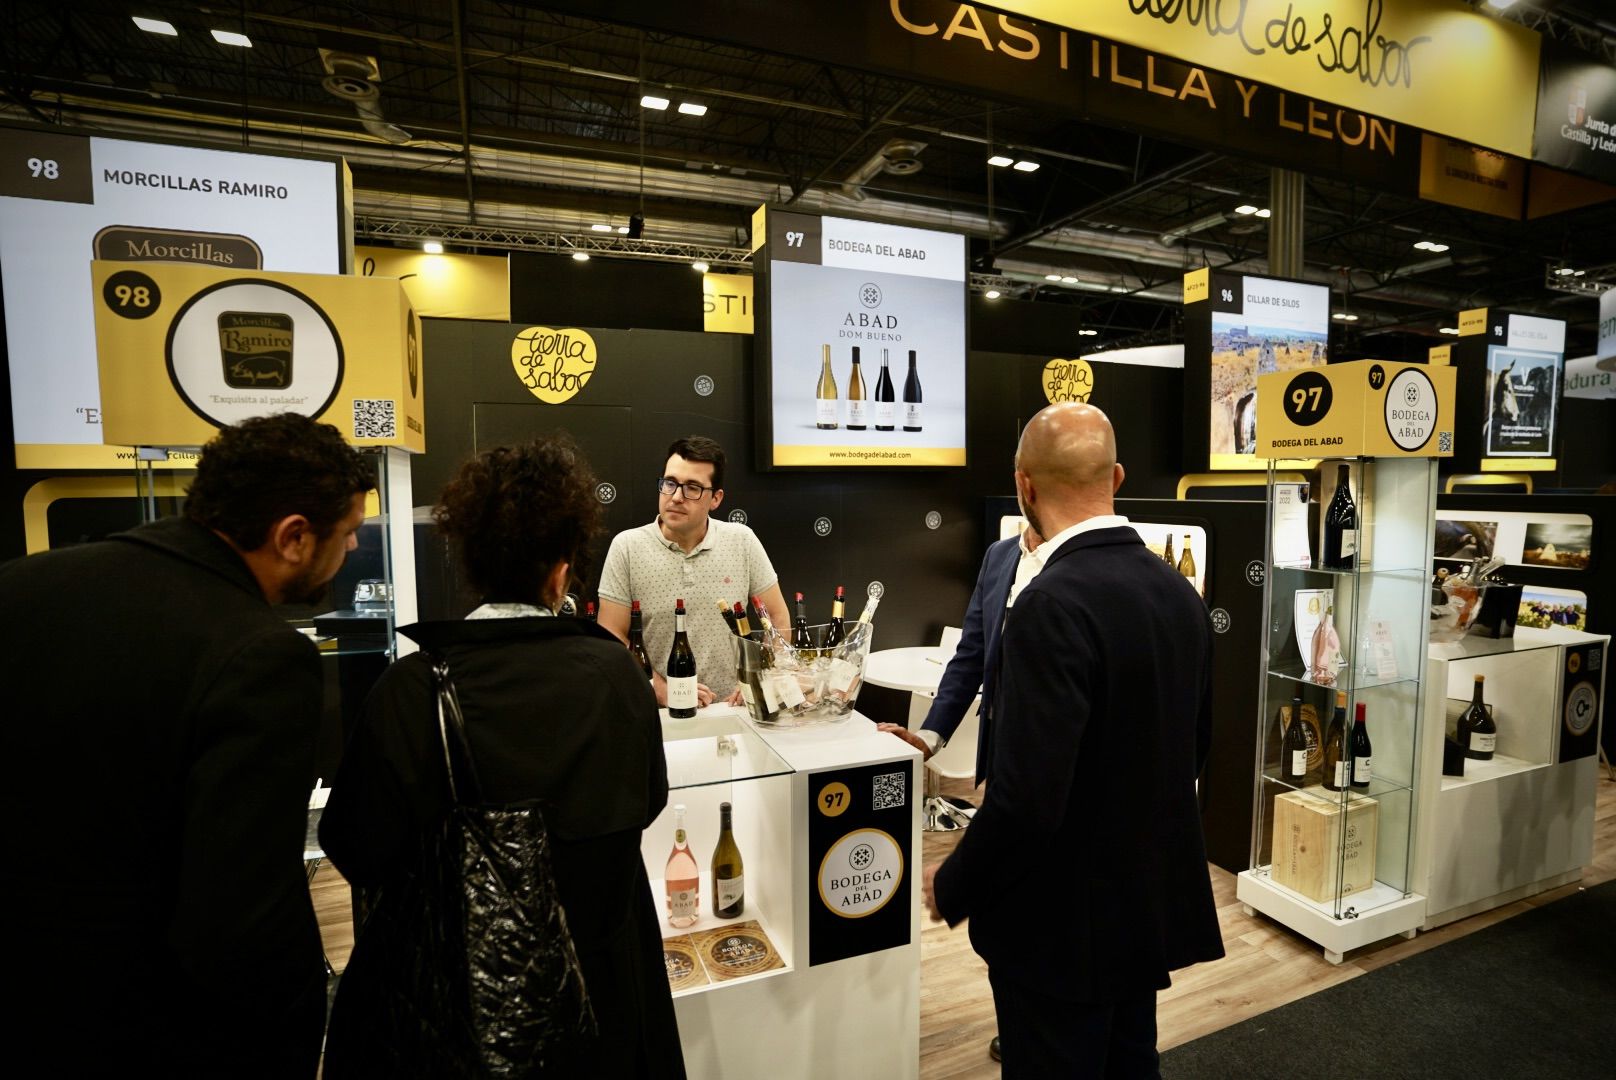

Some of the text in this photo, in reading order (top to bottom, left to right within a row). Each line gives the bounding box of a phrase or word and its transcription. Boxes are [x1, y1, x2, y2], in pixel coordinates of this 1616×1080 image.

[1265, 3, 1311, 55] de
[1314, 0, 1433, 88] sabor
[1235, 79, 1259, 118] Y
[1585, 115, 1609, 135] Junta
[1561, 124, 1591, 145] Castilla
[1591, 136, 1599, 150] y
[27, 157, 60, 180] 98
[103, 168, 289, 200] MORCILLAS RAMIRO
[785, 231, 804, 248] 97
[125, 238, 235, 265] Morcillas
[828, 239, 926, 260] BODEGA DEL ABAD
[114, 284, 151, 308] 98
[1221, 289, 1233, 302] 96
[1246, 294, 1300, 308] CILLAR DE SILOS
[231, 317, 281, 328] Morcillas
[843, 311, 899, 330] ABAD
[221, 329, 292, 352] Ramiro
[838, 329, 903, 343] DOM BUENO
[515, 331, 594, 364] tierra
[520, 352, 546, 368] de
[524, 356, 594, 392] sabor
[1045, 361, 1092, 387] tierra
[1371, 372, 1383, 384] 97
[1047, 379, 1063, 391] de
[1292, 386, 1323, 413] 97
[75, 407, 104, 425] “E
[1391, 409, 1430, 421] BODEGA
[1398, 427, 1424, 438] ABAD
[1272, 436, 1344, 448] BODEGA DEL ABAD
[829, 450, 912, 460] www.bodegadelabad.com
[824, 792, 844, 809] 97
[830, 868, 892, 891] BODEGA
[855, 884, 869, 892] DEL
[841, 890, 882, 907] ABAD
